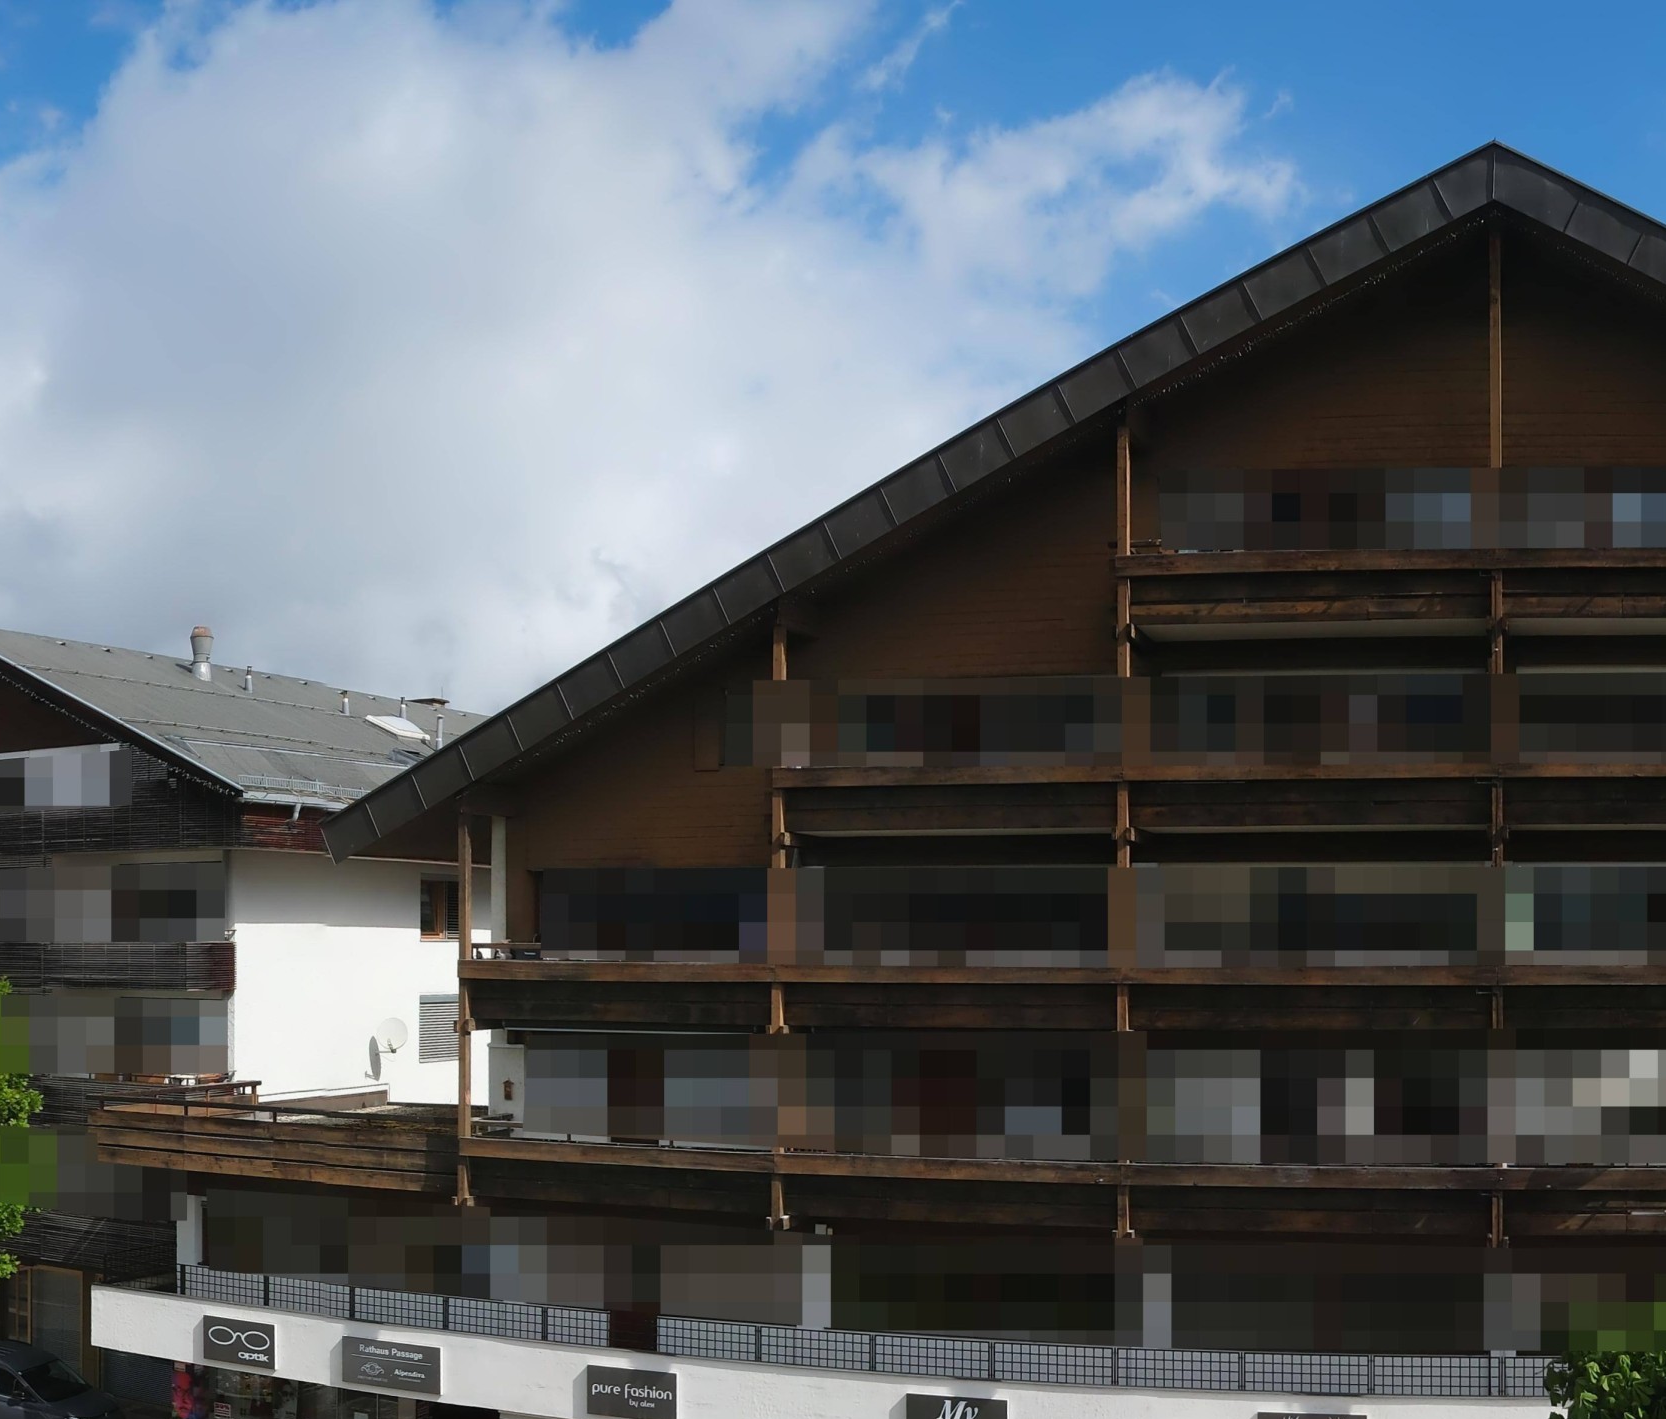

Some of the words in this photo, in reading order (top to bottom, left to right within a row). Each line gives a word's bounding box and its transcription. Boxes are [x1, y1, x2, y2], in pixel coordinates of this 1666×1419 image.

[237, 1351, 269, 1363] optik
[359, 1344, 389, 1356] Rathaus
[391, 1348, 423, 1360] Passage
[592, 1383, 621, 1396] pure
[624, 1383, 673, 1400] fashion
[629, 1399, 638, 1408] by
[640, 1400, 655, 1408] alex
